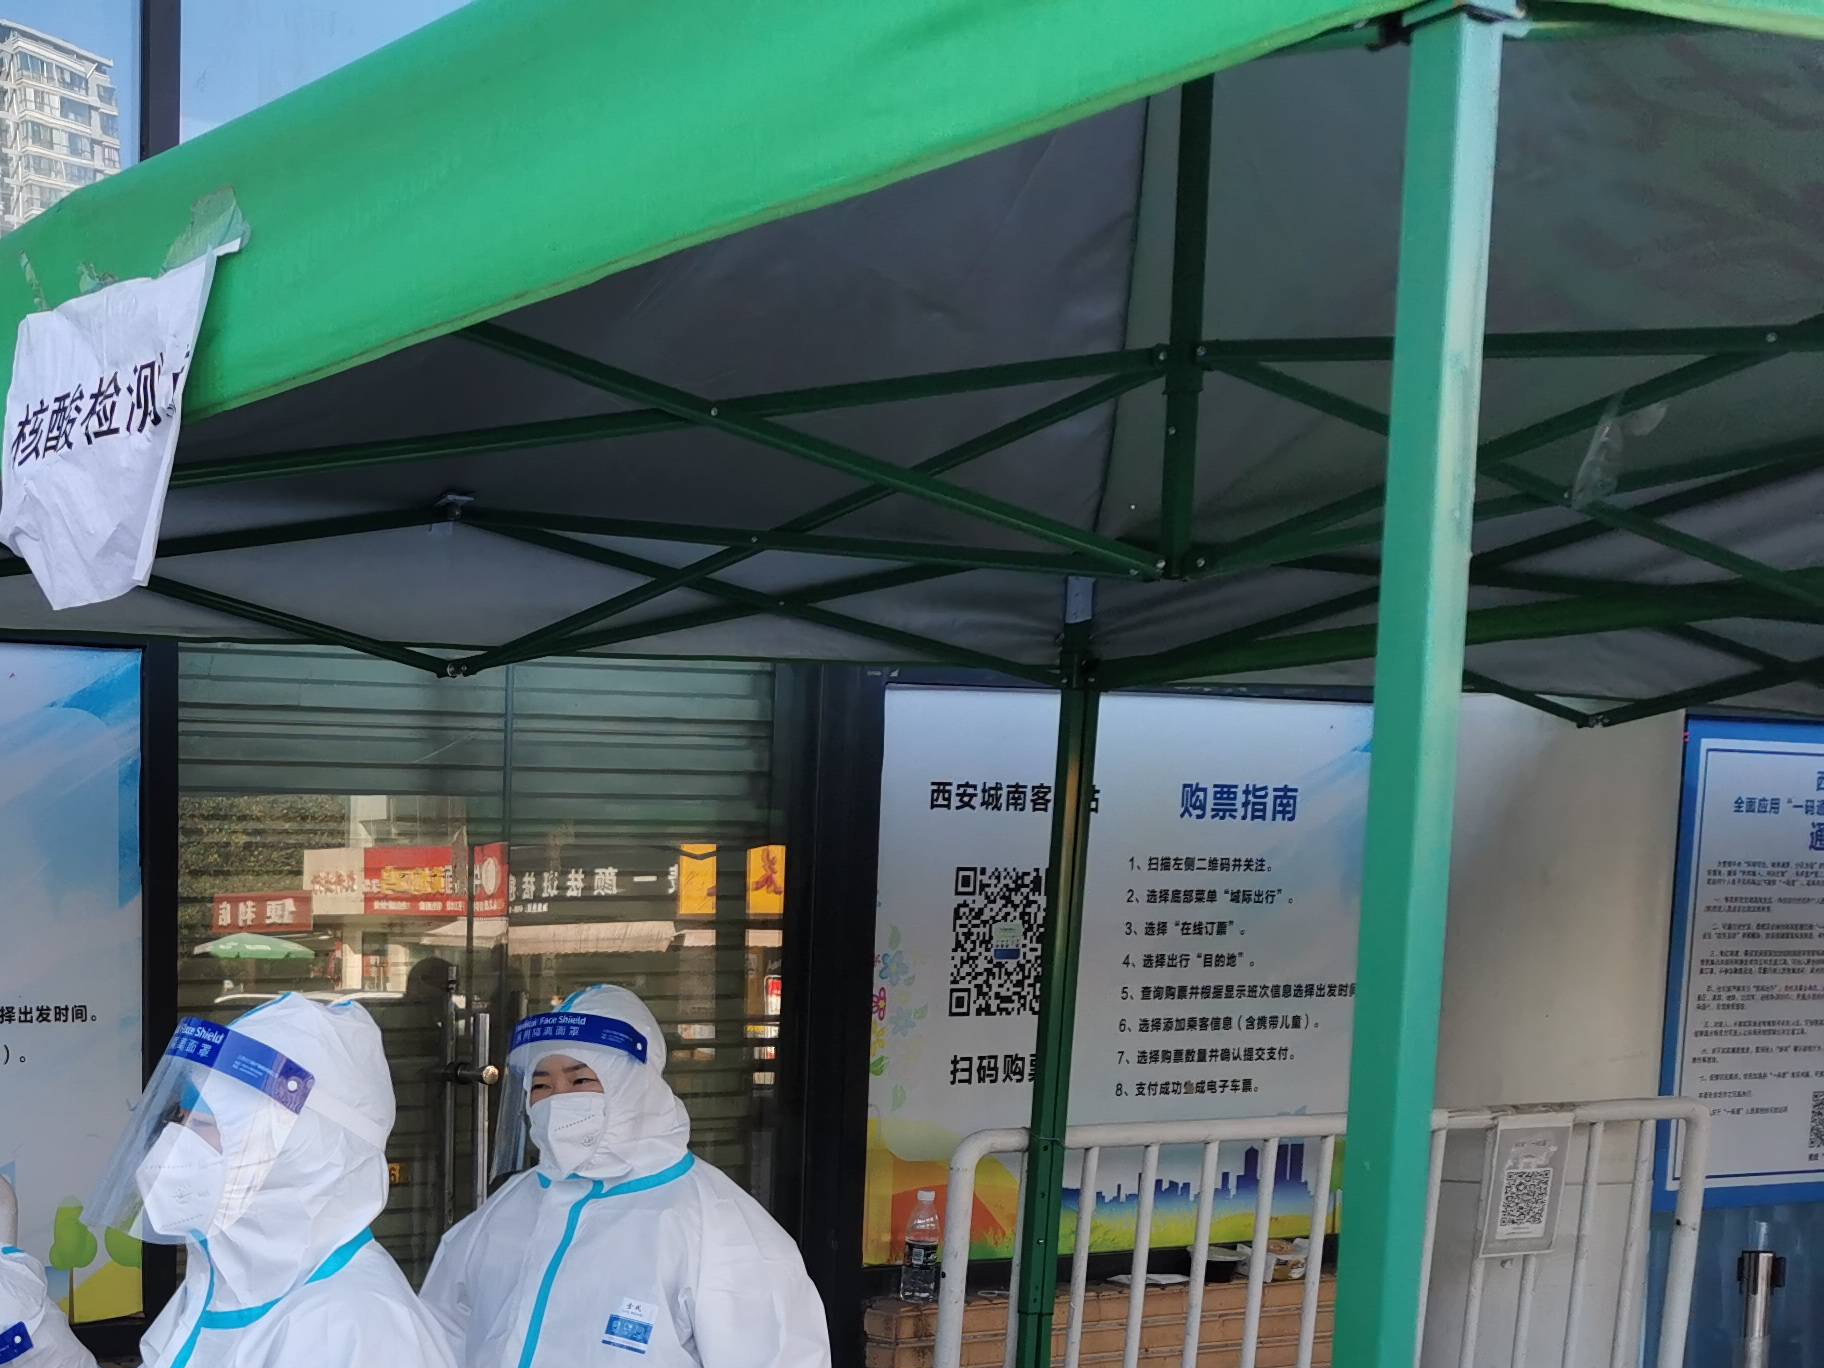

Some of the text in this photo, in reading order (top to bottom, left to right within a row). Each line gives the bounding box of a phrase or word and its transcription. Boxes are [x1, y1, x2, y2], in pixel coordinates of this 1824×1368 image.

[929, 780, 1100, 815] 西安城南客
[1178, 782, 1300, 822] 购票指南
[1128, 855, 1273, 874] 1、扫描左侧二维码并关注。
[1126, 888, 1294, 906] 2、选择底部菜单“城际出行”。
[1124, 920, 1247, 938] 3、选择“在线订票”。
[1122, 951, 1256, 970] 4、选择出行“目的地”。
[559, 1015, 586, 1026] Shield
[196, 1025, 225, 1045] Shield
[1116, 1046, 1296, 1066] 7、选择购票数量并确认提交支付。
